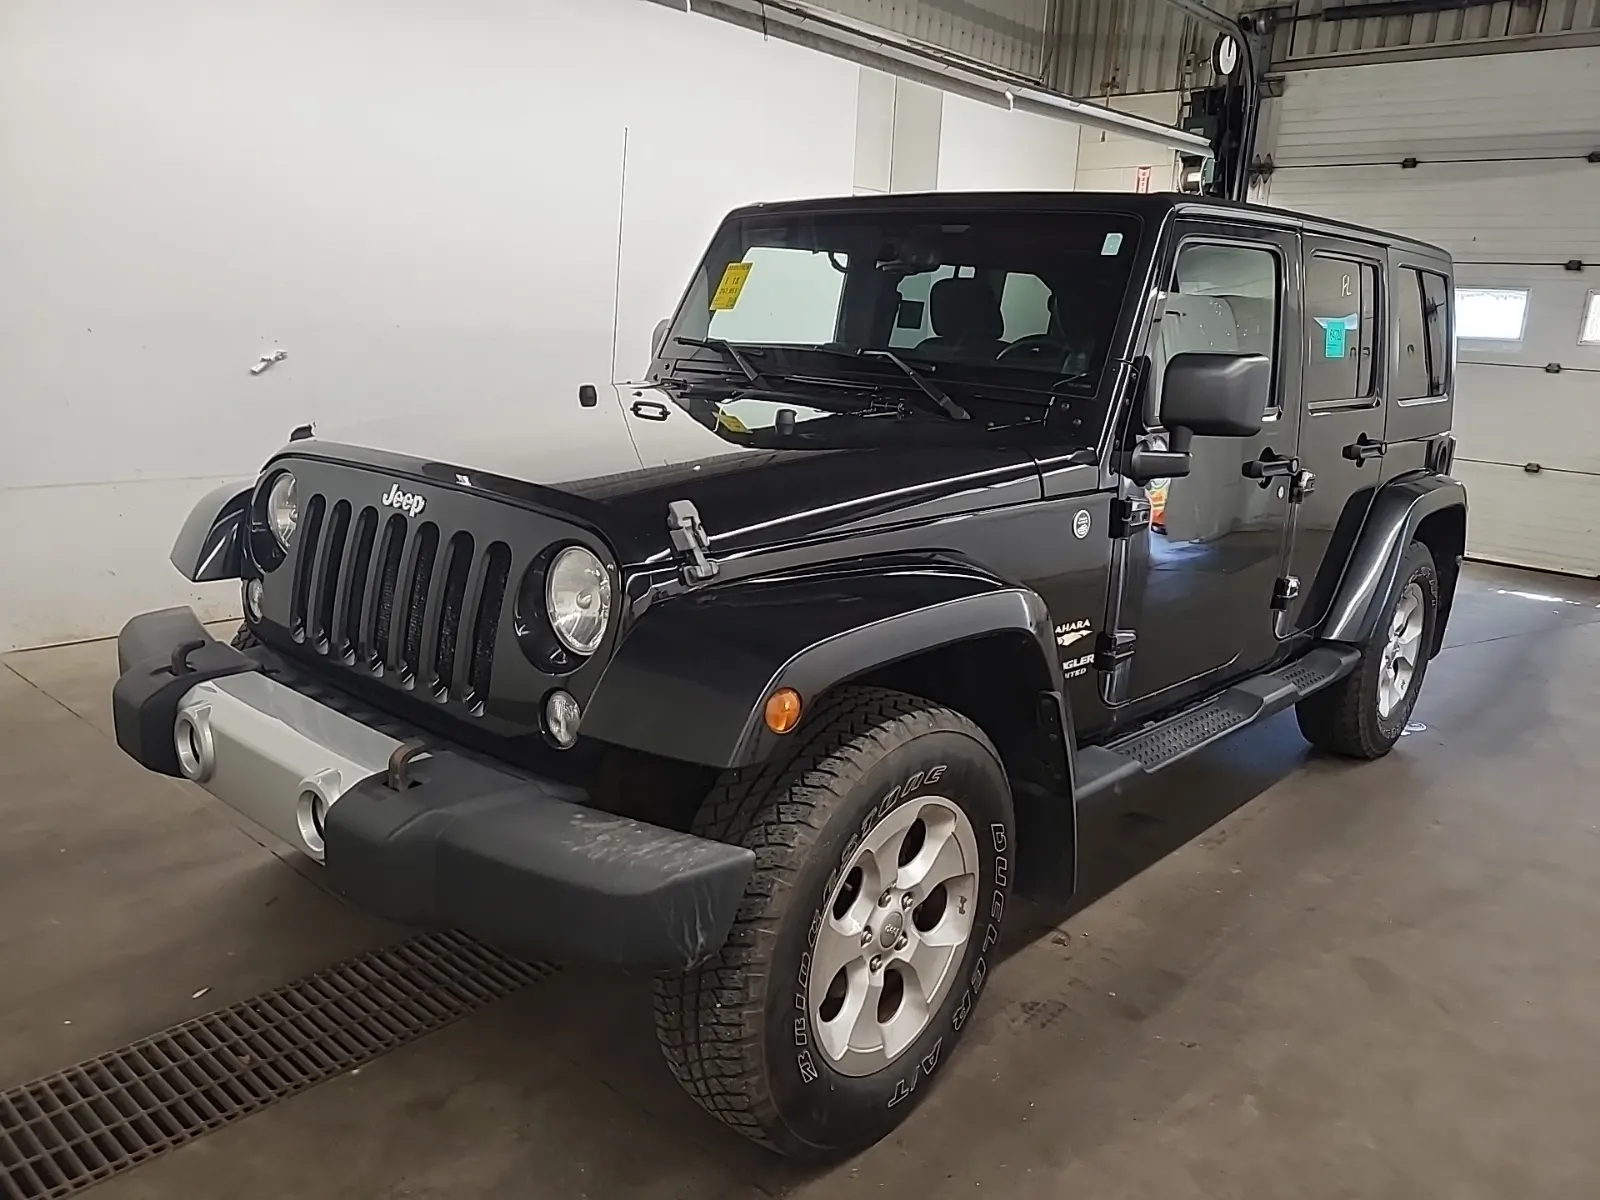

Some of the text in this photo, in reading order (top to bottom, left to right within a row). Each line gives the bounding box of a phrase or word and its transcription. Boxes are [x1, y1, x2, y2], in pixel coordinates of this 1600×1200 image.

[382, 483, 426, 518] Jeep
[1054, 618, 1091, 634] AHARA
[887, 822, 1009, 1108] DUELER A/T
